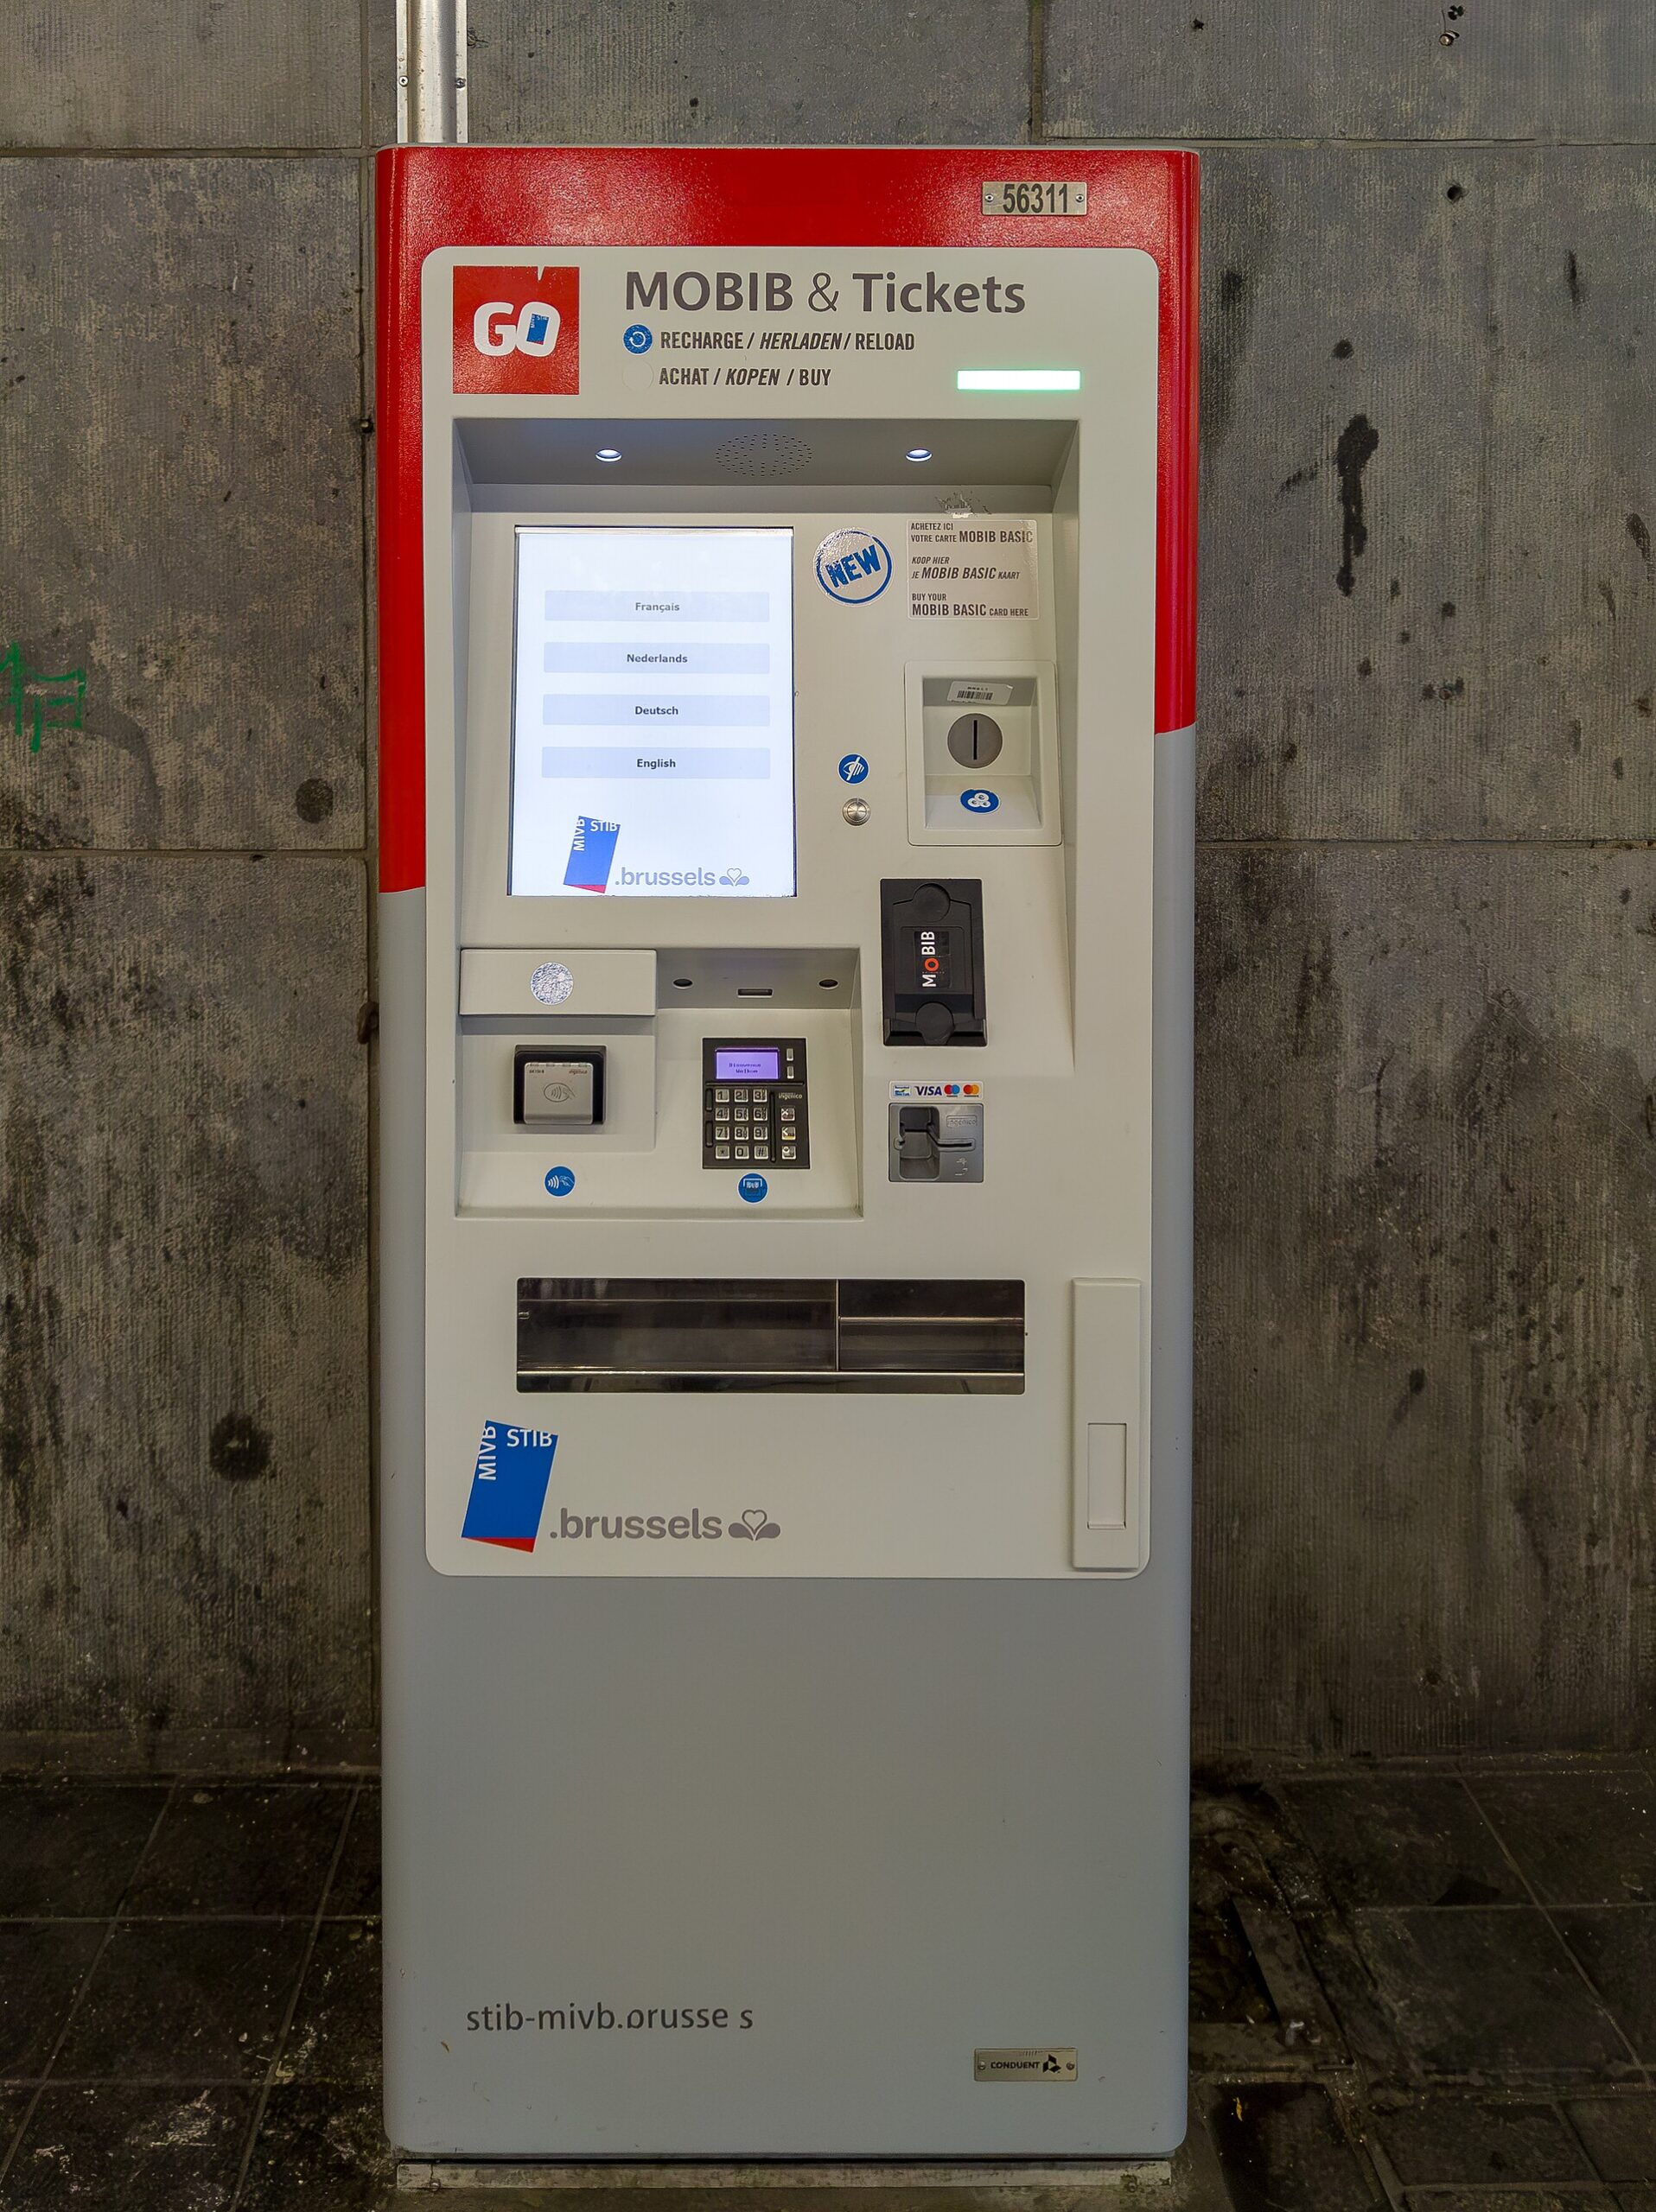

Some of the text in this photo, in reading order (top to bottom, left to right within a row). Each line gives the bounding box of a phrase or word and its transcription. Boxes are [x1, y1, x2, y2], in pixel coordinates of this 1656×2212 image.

[1002, 183, 1068, 214] 56311
[626, 270, 1026, 314] MOBIB & Tickets
[472, 300, 562, 358] GO
[660, 331, 744, 350] RECHARGE
[759, 332, 843, 350] HERLADEN
[855, 333, 915, 351] RELOAD
[659, 367, 710, 385] ACHAT
[724, 368, 780, 386] KOPEN
[799, 368, 831, 386] BUY
[910, 522, 953, 531] ACHETEZ ICI
[910, 531, 1033, 543] VOTRE CARTE MOBIB BASIC
[825, 543, 882, 589] NEW
[911, 556, 950, 565] KOOP HIER
[911, 567, 1020, 580] JE MOBIB BASIC KAART
[912, 593, 947, 601] BUY YOUR
[635, 601, 680, 613] Français
[912, 603, 1029, 617] MOBIB BASIC CARD HERE
[627, 653, 688, 664] Nederlands
[634, 706, 678, 715] Deutsch
[636, 758, 676, 770] English
[589, 819, 618, 832] STIB
[615, 867, 716, 887] .brussels
[920, 931, 939, 988] MOBIB
[914, 1085, 943, 1096] VISA
[506, 1428, 553, 1447] STIB
[477, 1426, 497, 1481] MIVB
[550, 1507, 723, 1540] .brussels
[990, 2061, 1041, 2069] CONDUENT
